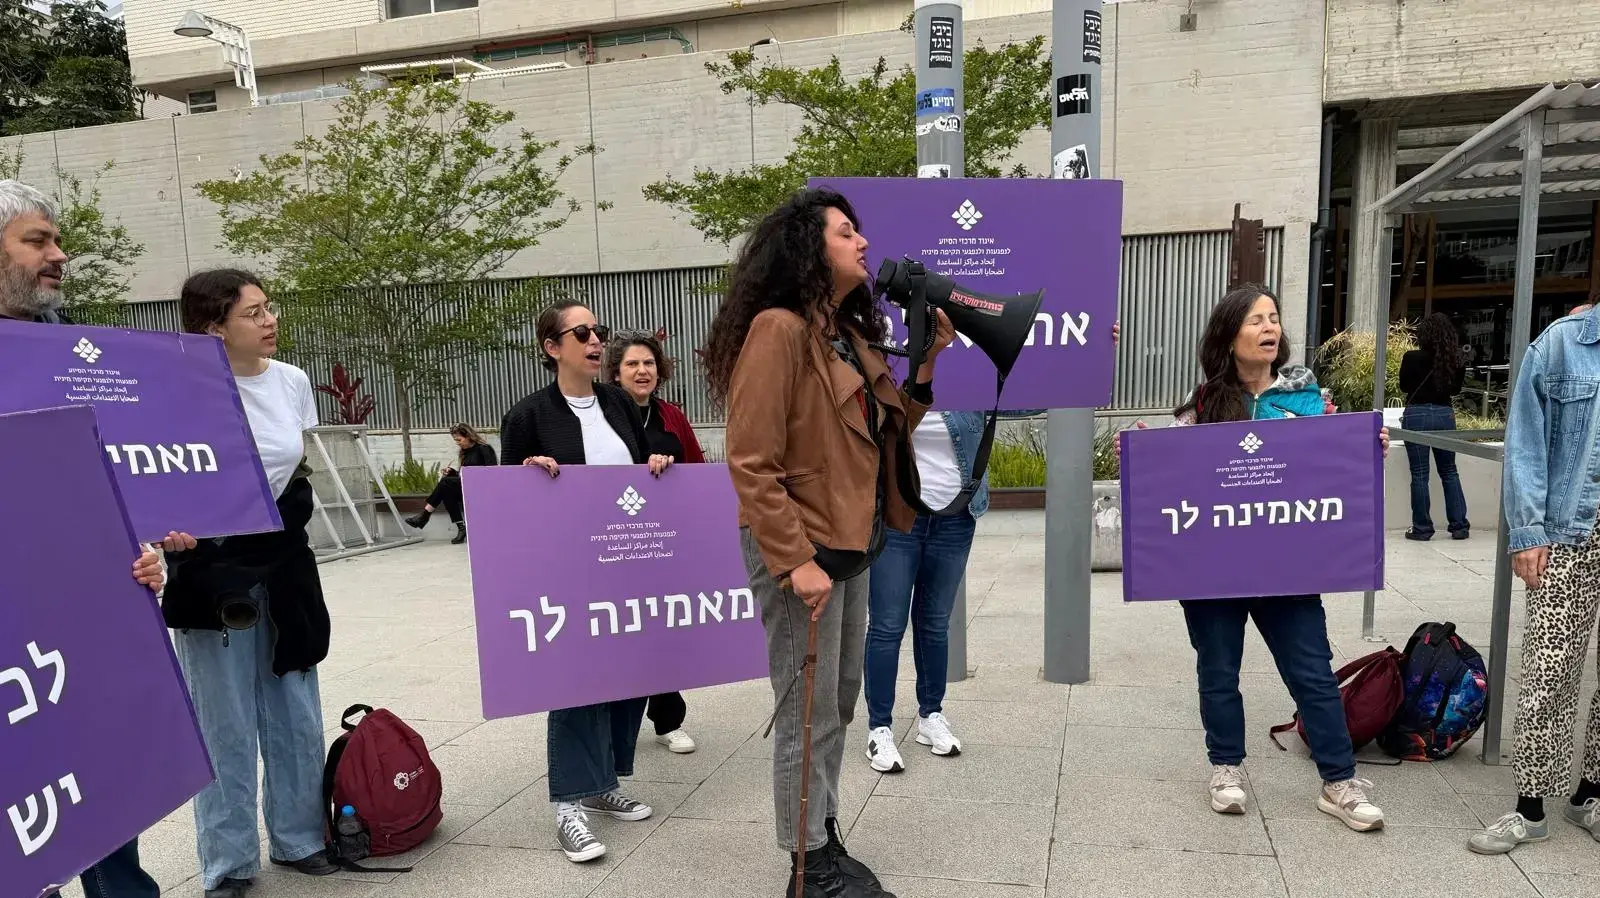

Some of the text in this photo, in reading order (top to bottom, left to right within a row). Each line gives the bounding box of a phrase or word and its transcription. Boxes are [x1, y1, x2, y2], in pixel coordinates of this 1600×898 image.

[932, 25, 952, 36] ביבי
[932, 38, 952, 48] בוגד
[1024, 311, 1090, 346] את
[1161, 497, 1343, 535] מאמינה לך
[654, 530, 676, 538] לנפגעות
[509, 587, 755, 652] מאמינה לך
[7, 772, 82, 856] יש
